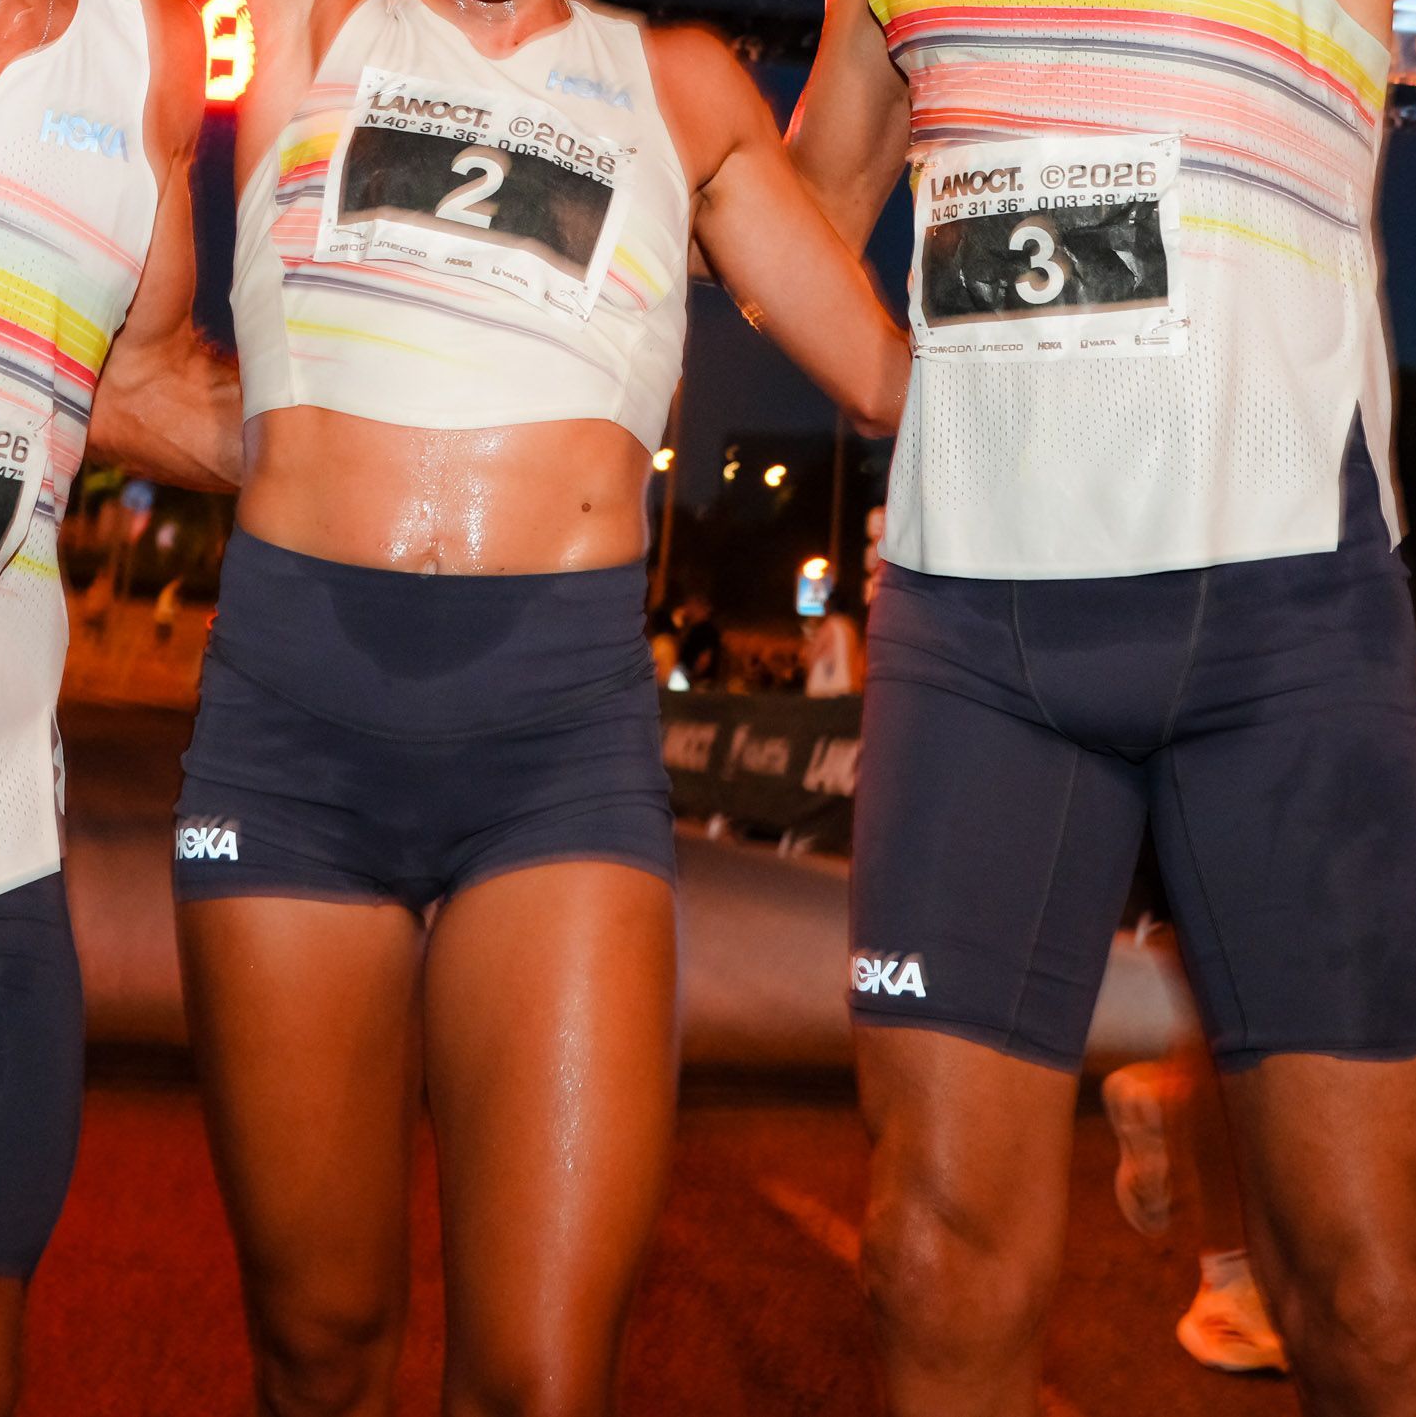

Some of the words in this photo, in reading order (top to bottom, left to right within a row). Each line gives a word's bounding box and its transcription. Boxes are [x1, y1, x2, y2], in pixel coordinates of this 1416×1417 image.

[365, 114, 381, 125] N
[369, 92, 493, 130] LANOCT.
[39, 107, 131, 164] HOKA
[435, 155, 505, 230] 2
[930, 166, 1024, 202] LANOCT.
[931, 208, 941, 222] N
[1009, 225, 1065, 305] 3
